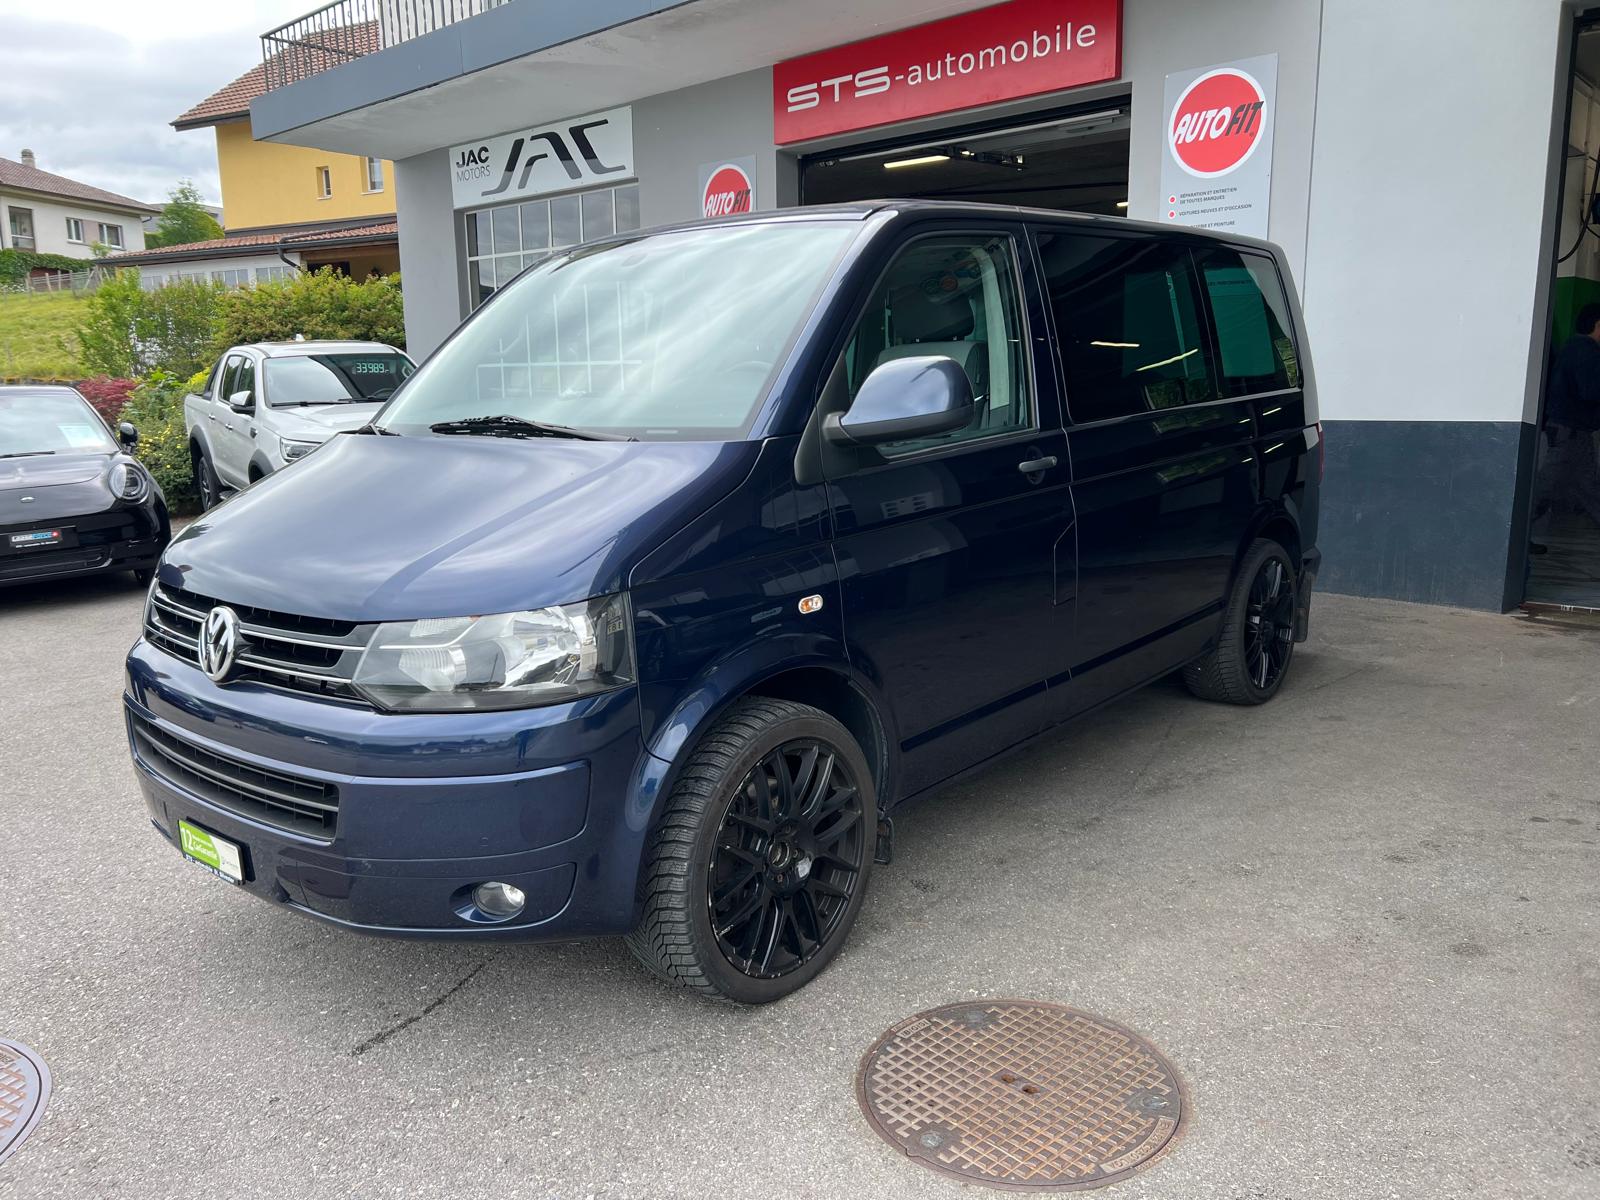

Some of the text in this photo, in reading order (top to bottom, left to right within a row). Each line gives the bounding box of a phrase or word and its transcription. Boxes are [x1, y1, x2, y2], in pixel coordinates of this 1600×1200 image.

[786, 22, 1096, 112] STS-automobile
[1173, 101, 1264, 145] AUTOFIT
[456, 146, 490, 169] JAC
[456, 164, 491, 183] MOTORS
[705, 189, 752, 217] AUTOFIT
